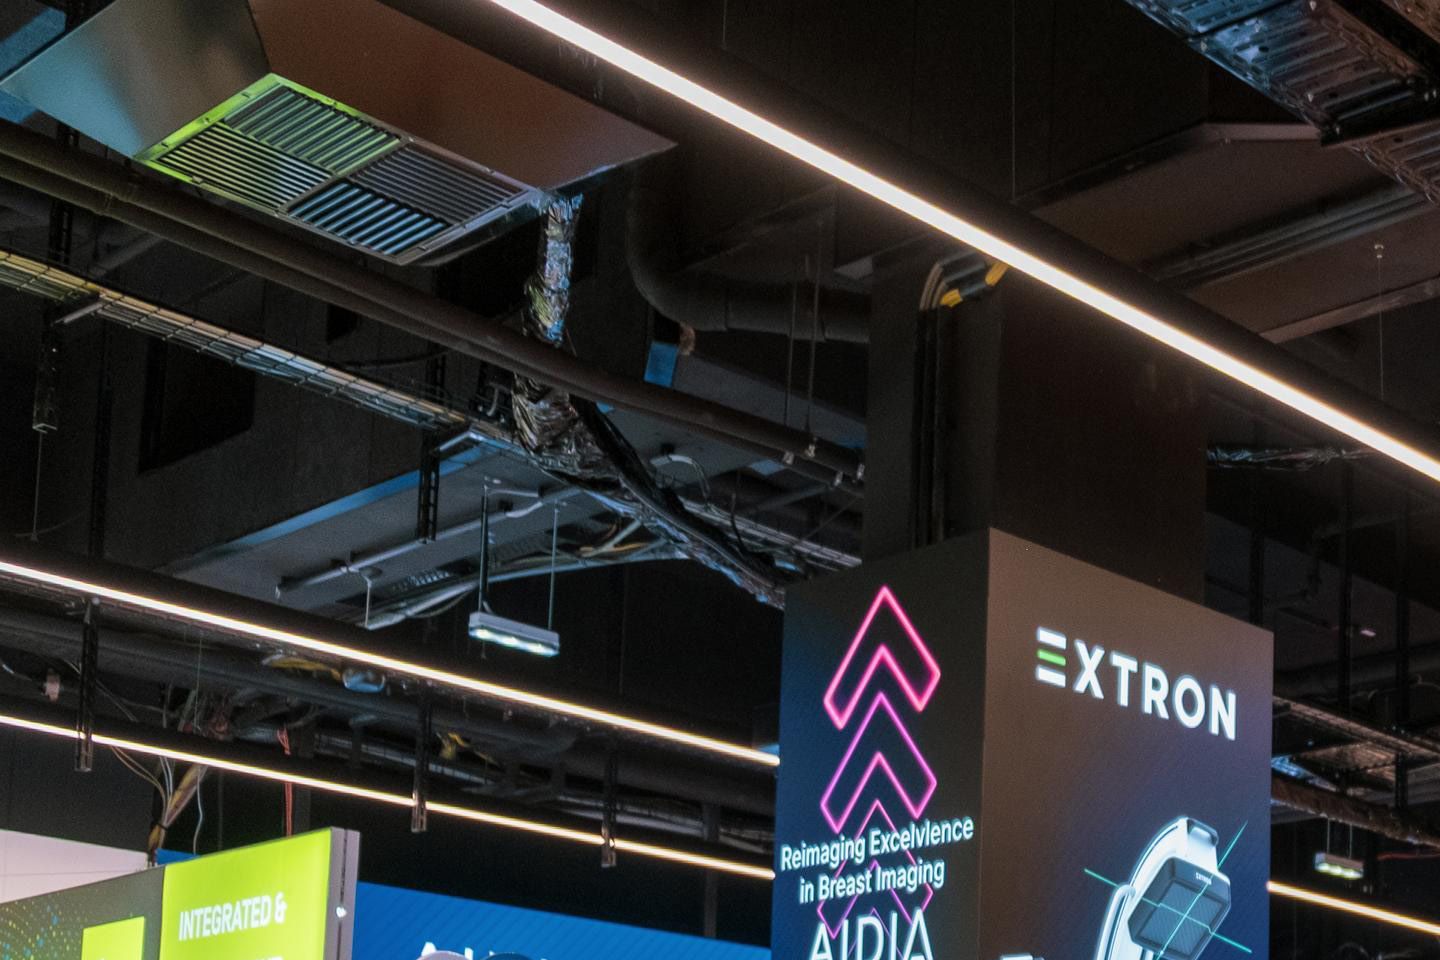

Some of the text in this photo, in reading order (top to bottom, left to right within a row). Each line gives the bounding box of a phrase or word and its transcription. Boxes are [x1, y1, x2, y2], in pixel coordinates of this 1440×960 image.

[1035, 626, 1238, 740] EXTRON
[780, 834, 866, 871] Reimaging
[799, 858, 945, 904] in Breast Imaging
[178, 892, 287, 941] INTEGRATED &
